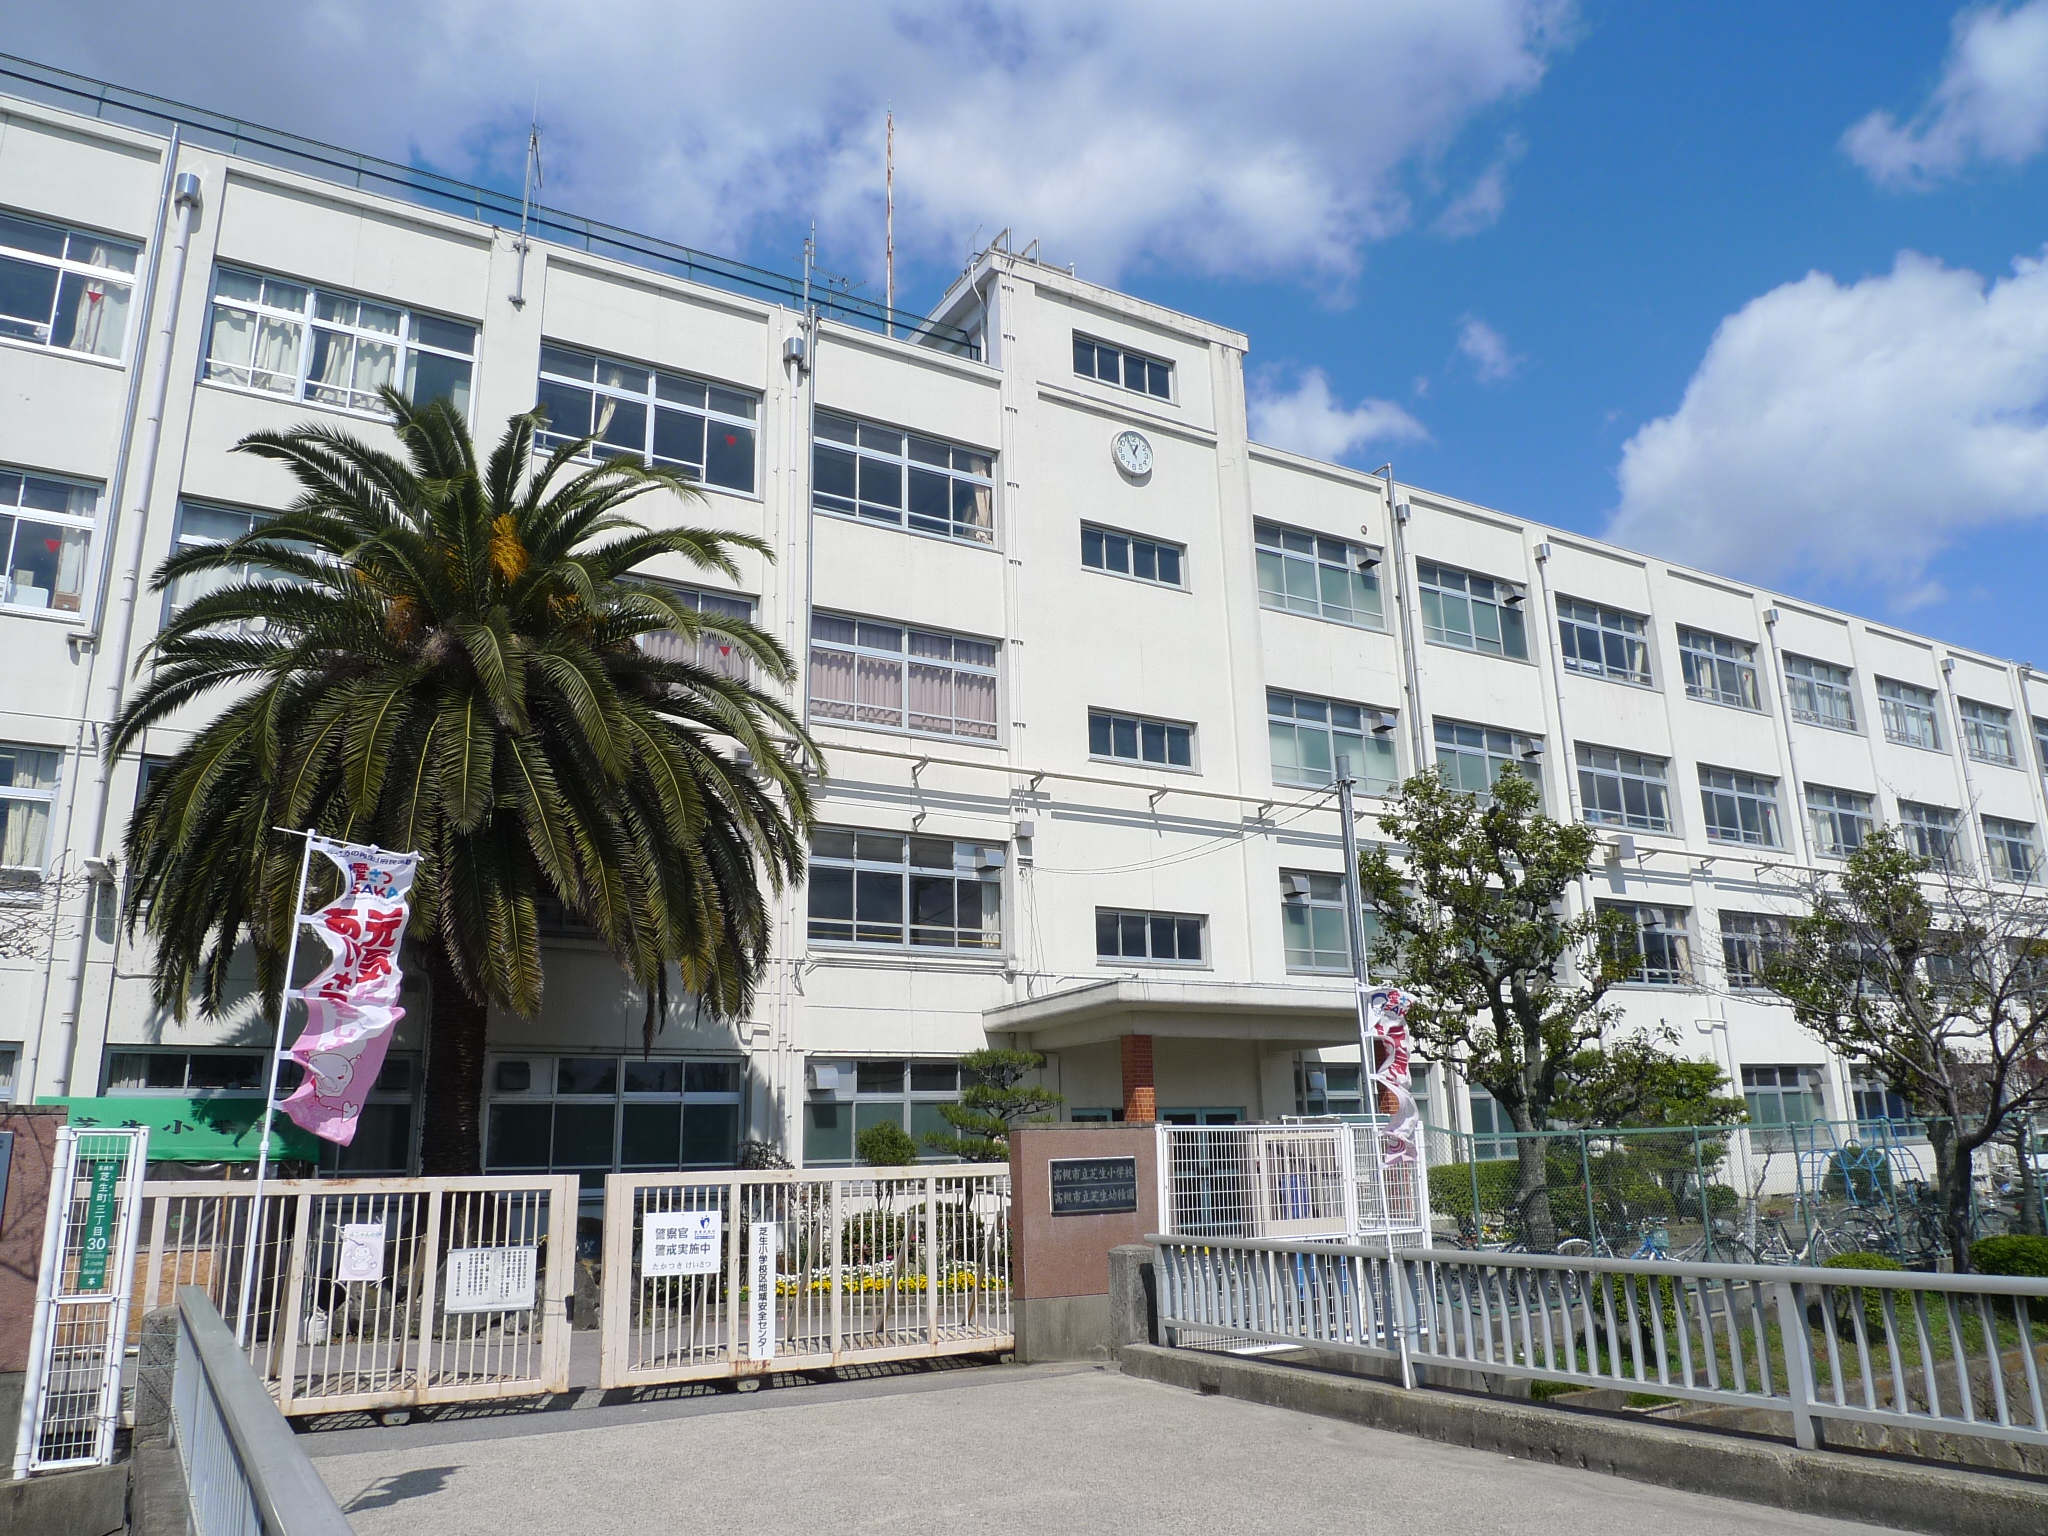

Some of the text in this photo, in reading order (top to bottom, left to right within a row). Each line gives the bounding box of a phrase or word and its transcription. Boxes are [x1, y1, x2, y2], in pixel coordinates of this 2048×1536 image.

[655, 1227, 689, 1240] 警察官
[86, 1237, 106, 1250] 30
[655, 1242, 711, 1257] 警戒実施中
[652, 1261, 712, 1271] たかつき けいさつ
[758, 1226, 768, 1356] 芝生小学校区地域安全センター
